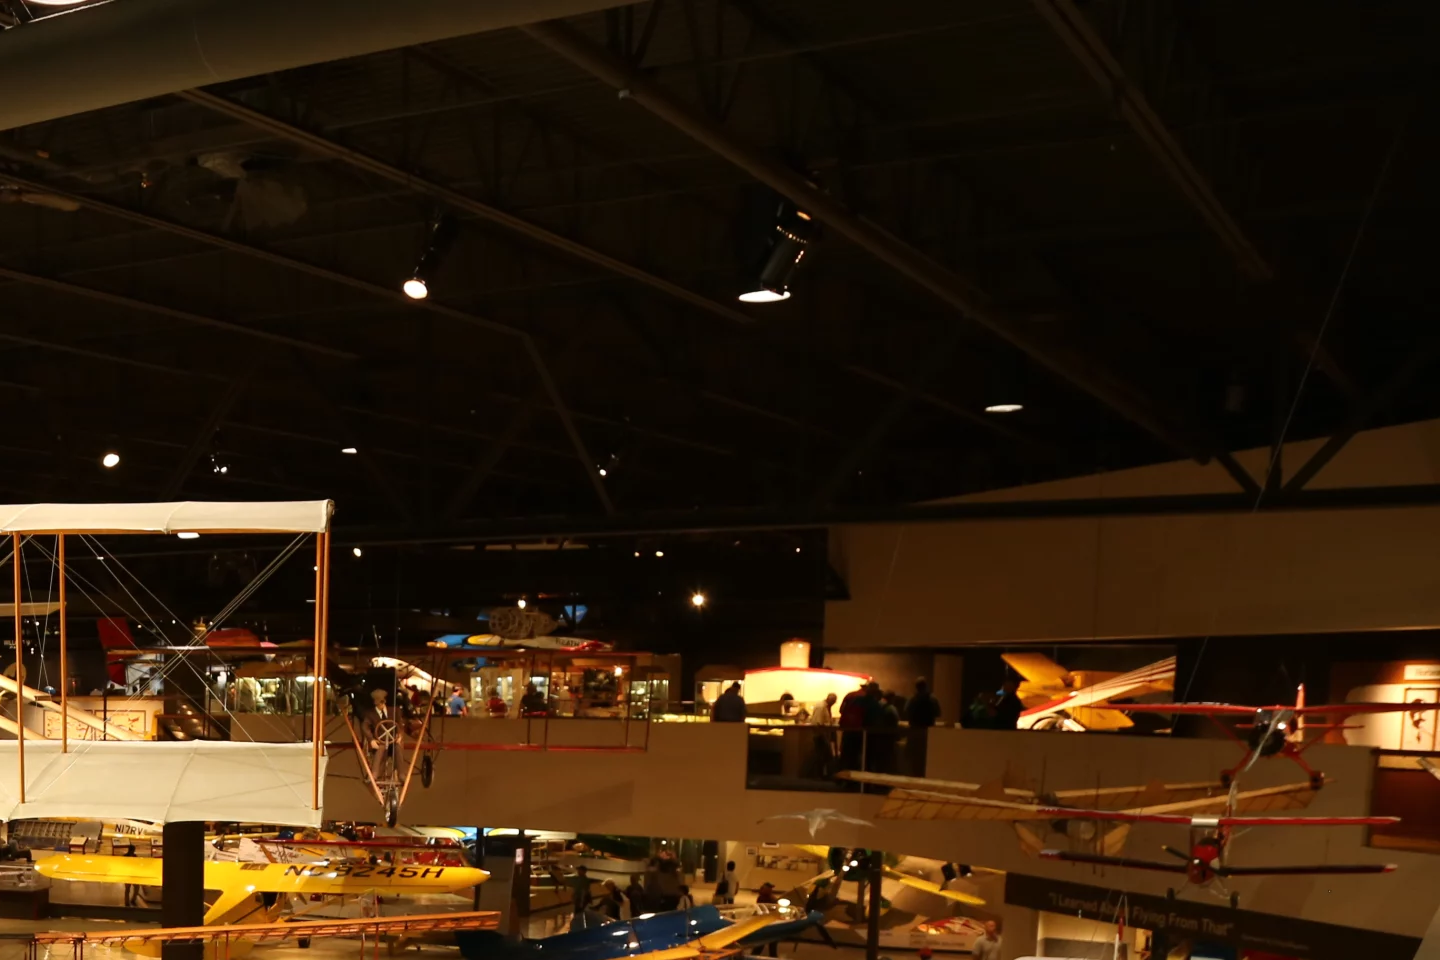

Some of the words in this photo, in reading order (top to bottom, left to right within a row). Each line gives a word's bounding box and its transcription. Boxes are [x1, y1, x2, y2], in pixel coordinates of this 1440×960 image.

[114, 823, 144, 836] N17RV
[284, 864, 446, 879] NC9245H
[1131, 905, 1166, 928] Flying
[1168, 913, 1199, 931] From
